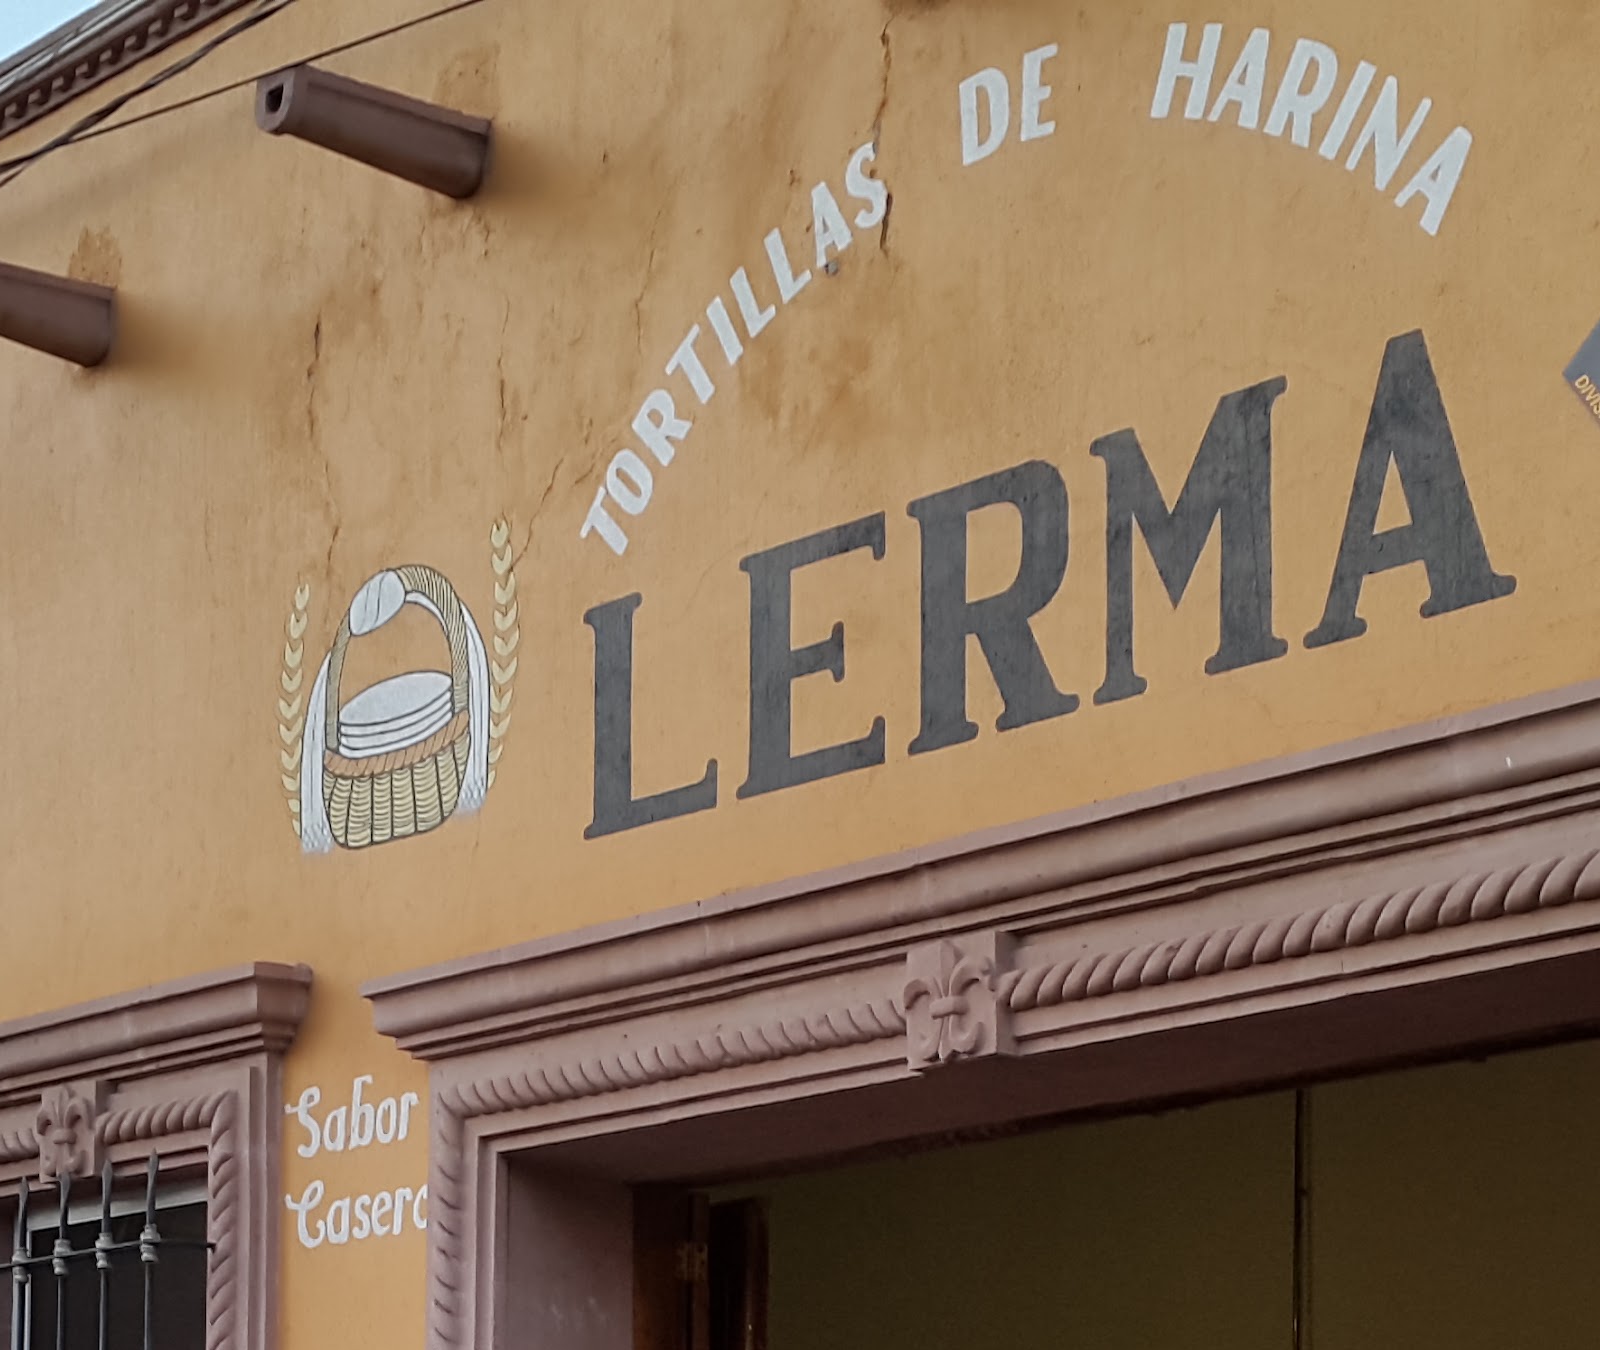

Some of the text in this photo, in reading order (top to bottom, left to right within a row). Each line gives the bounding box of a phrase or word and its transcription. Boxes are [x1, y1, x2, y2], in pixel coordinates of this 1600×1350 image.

[580, 21, 1474, 556] TORTILLAS DE HARINA
[583, 327, 1518, 842] LERMA
[284, 1074, 420, 1158] Sabor
